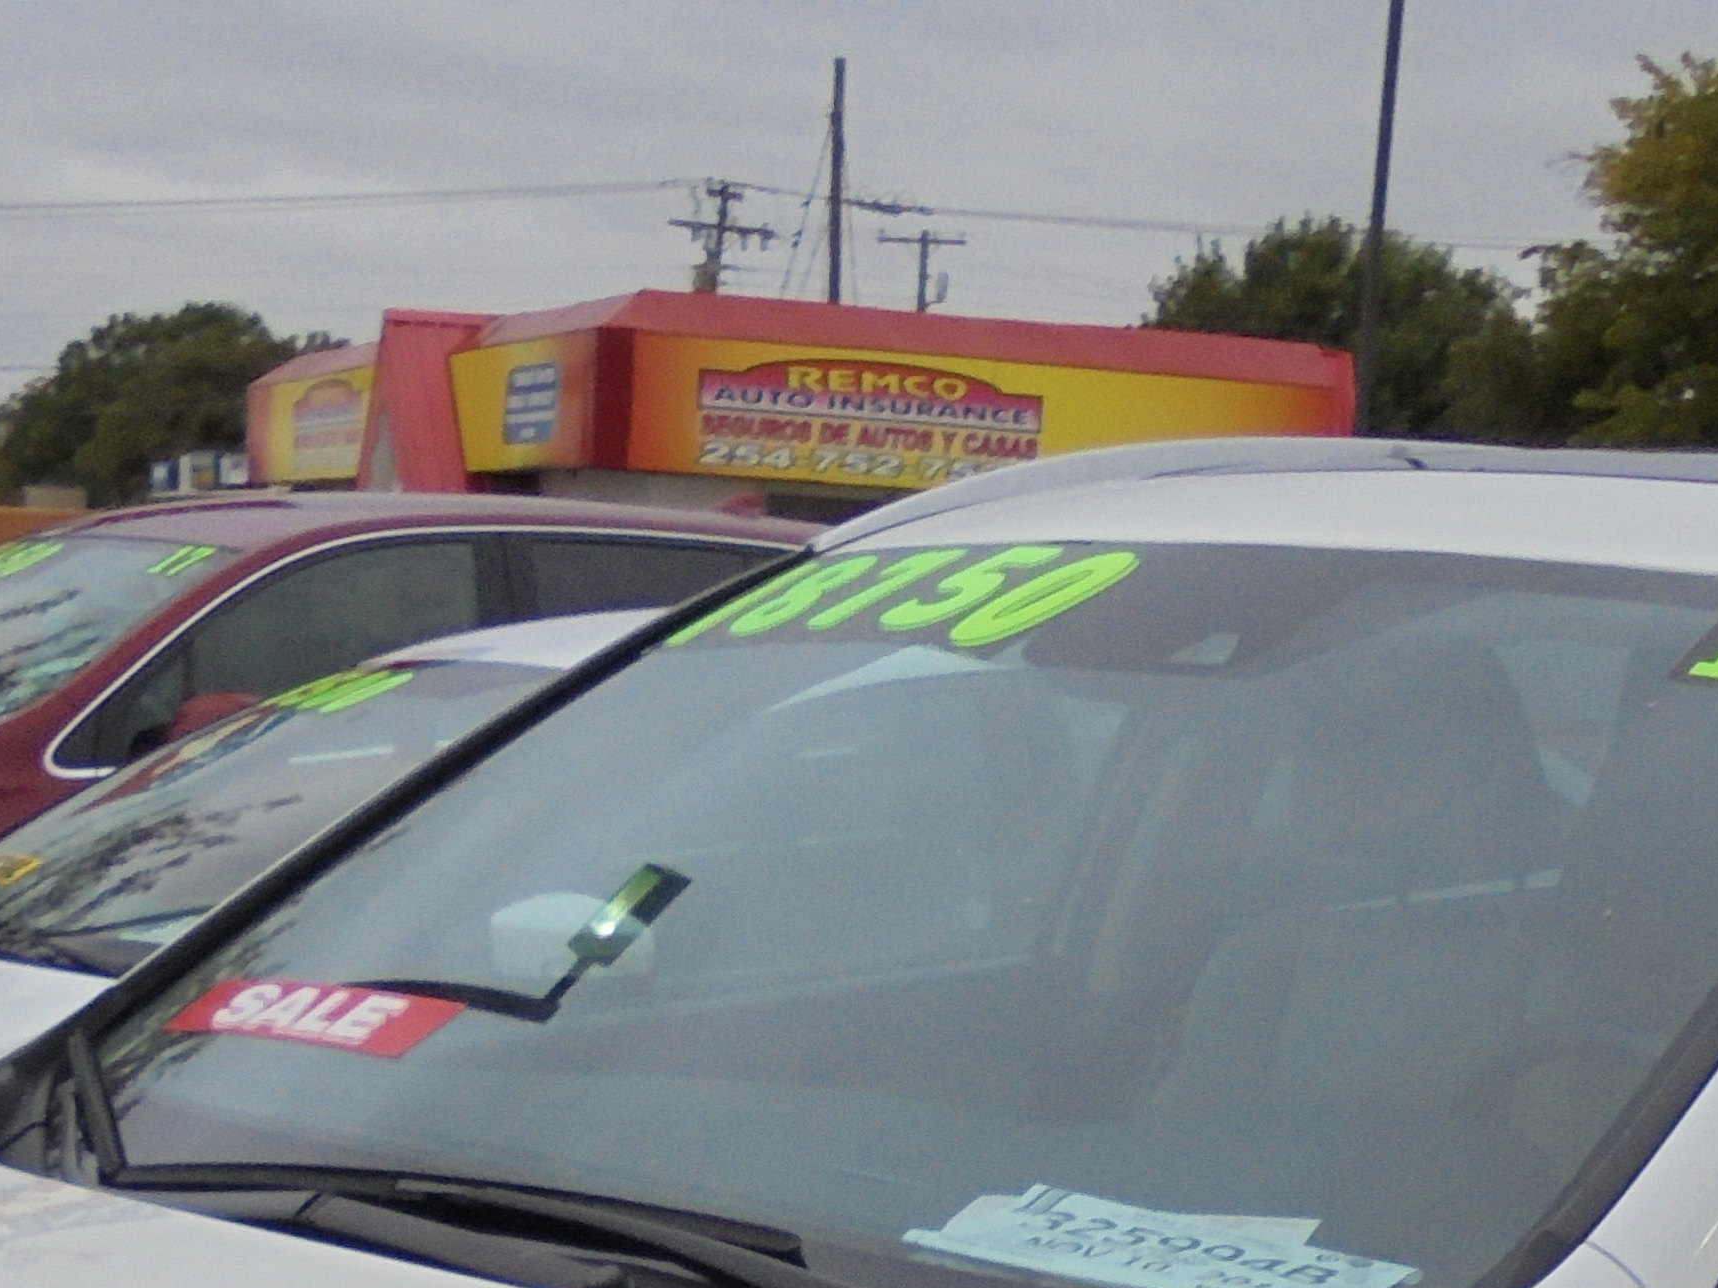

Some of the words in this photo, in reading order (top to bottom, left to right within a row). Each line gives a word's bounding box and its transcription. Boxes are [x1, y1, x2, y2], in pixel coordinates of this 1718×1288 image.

[787, 365, 969, 401] REMCO
[713, 386, 813, 409] AUTO
[825, 394, 1031, 427] INSURANCE
[701, 413, 813, 444] SEGUROS
[818, 421, 854, 447] DE
[855, 423, 935, 452] AUTOS
[940, 430, 959, 453] Y
[961, 432, 1039, 460] CASAS
[211, 982, 411, 1046] SALE
